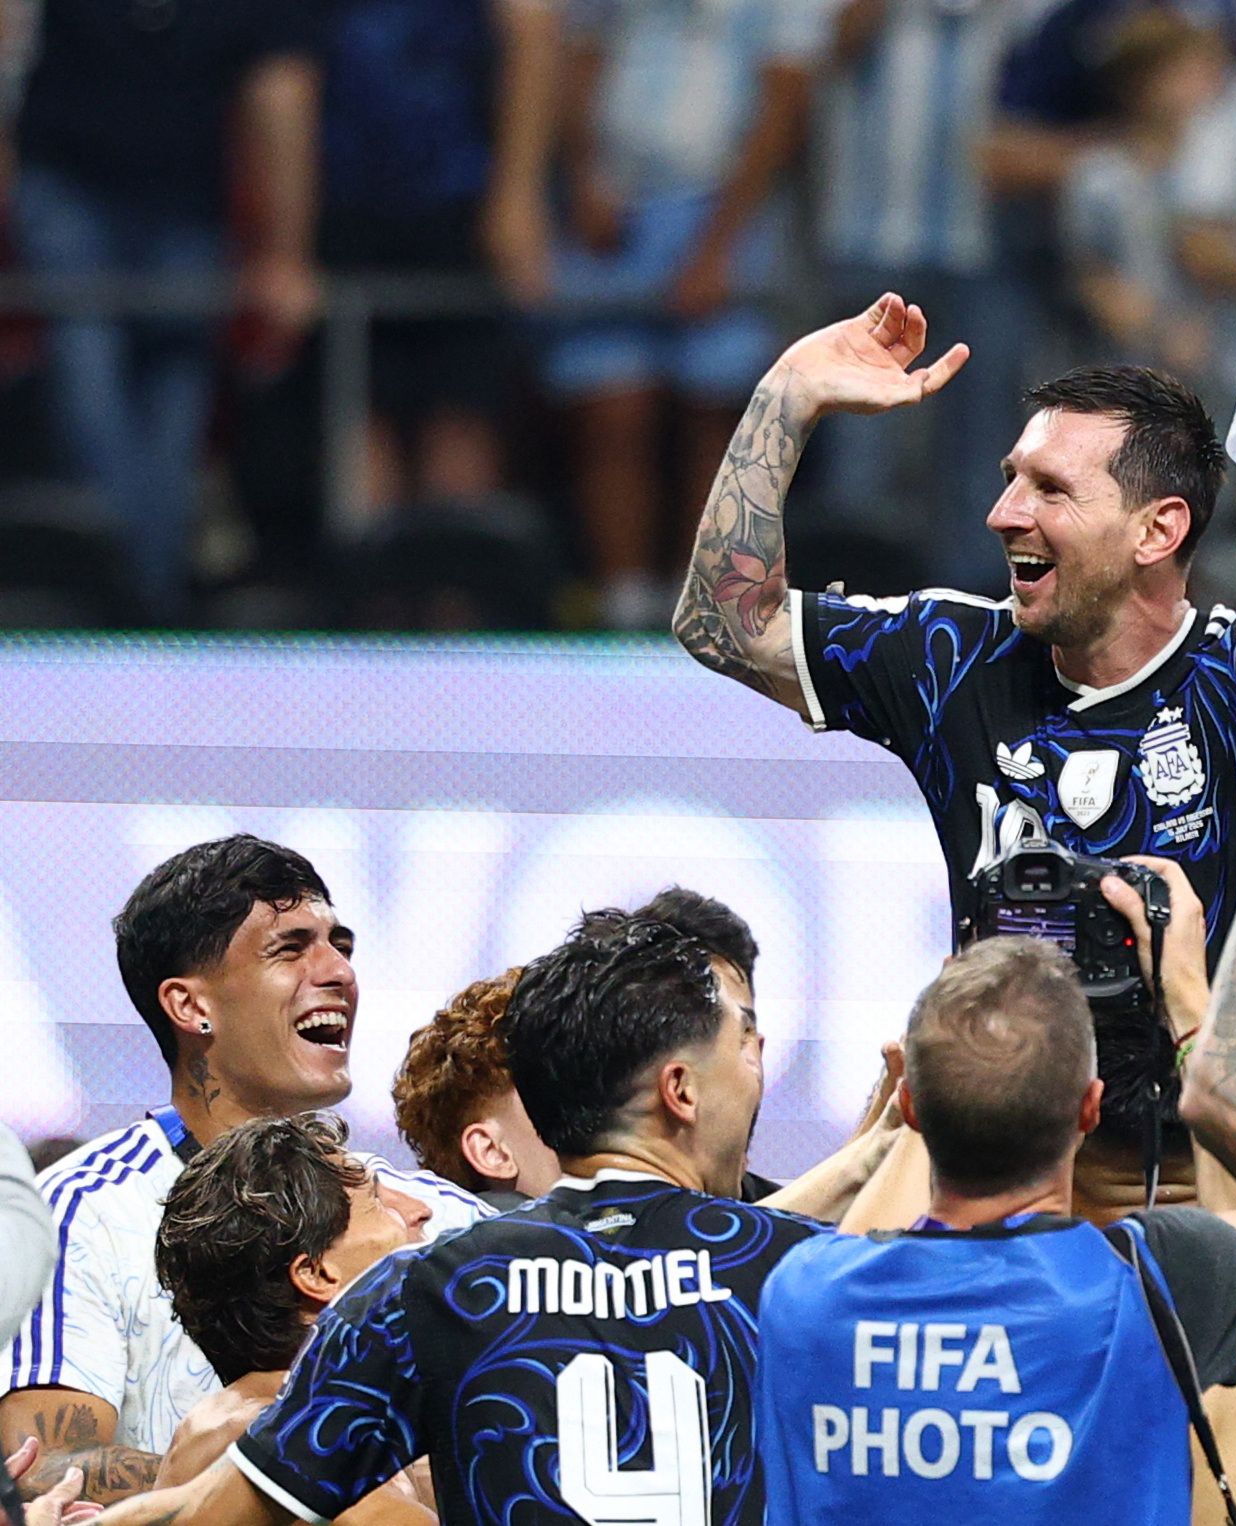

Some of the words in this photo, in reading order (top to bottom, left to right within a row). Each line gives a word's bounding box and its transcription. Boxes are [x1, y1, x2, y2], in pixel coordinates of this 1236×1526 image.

[1155, 748, 1189, 780] AFA
[1072, 796, 1096, 806] FIFA
[507, 1249, 732, 1319] MONTIEL
[854, 1320, 1022, 1394] FIFA
[556, 1350, 712, 1526] 4
[812, 1404, 1074, 1482] PHOTO
